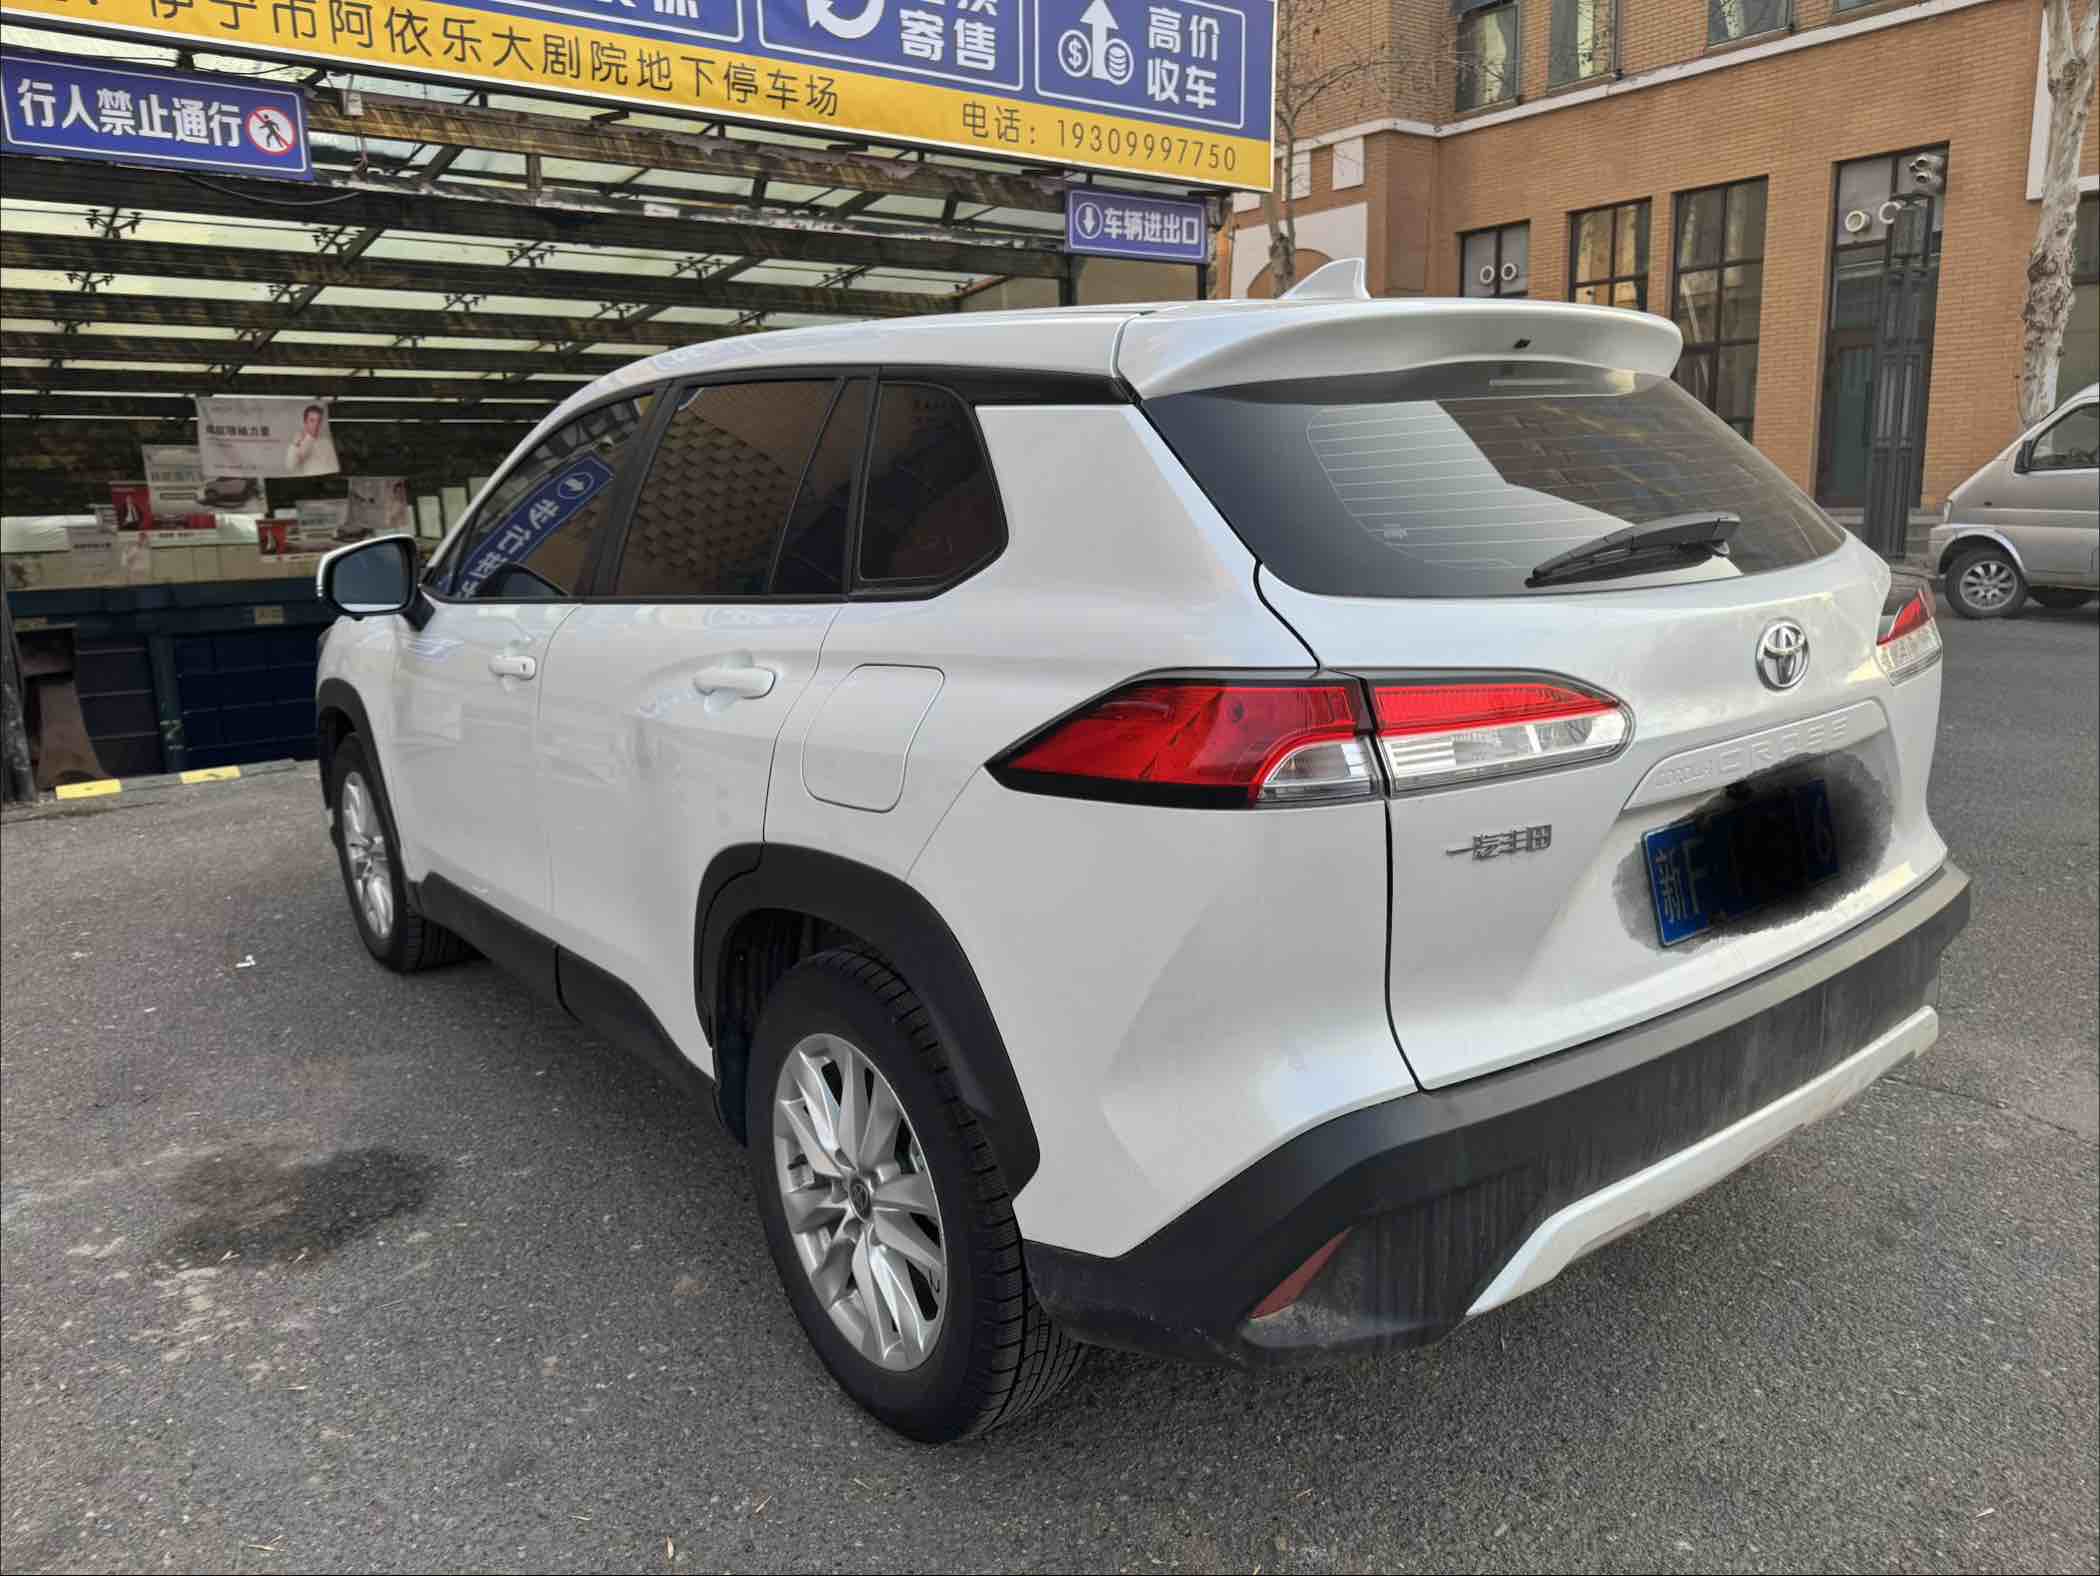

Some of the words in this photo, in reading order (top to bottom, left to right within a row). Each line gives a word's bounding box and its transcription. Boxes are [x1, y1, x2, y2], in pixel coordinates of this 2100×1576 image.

[900, 8, 996, 70] 寄售
[1148, 7, 1220, 61] 高价
[1147, 58, 1217, 109] 收车
[17, 78, 242, 148] 行人禁止通行
[1103, 207, 1200, 245] 车辆进出口
